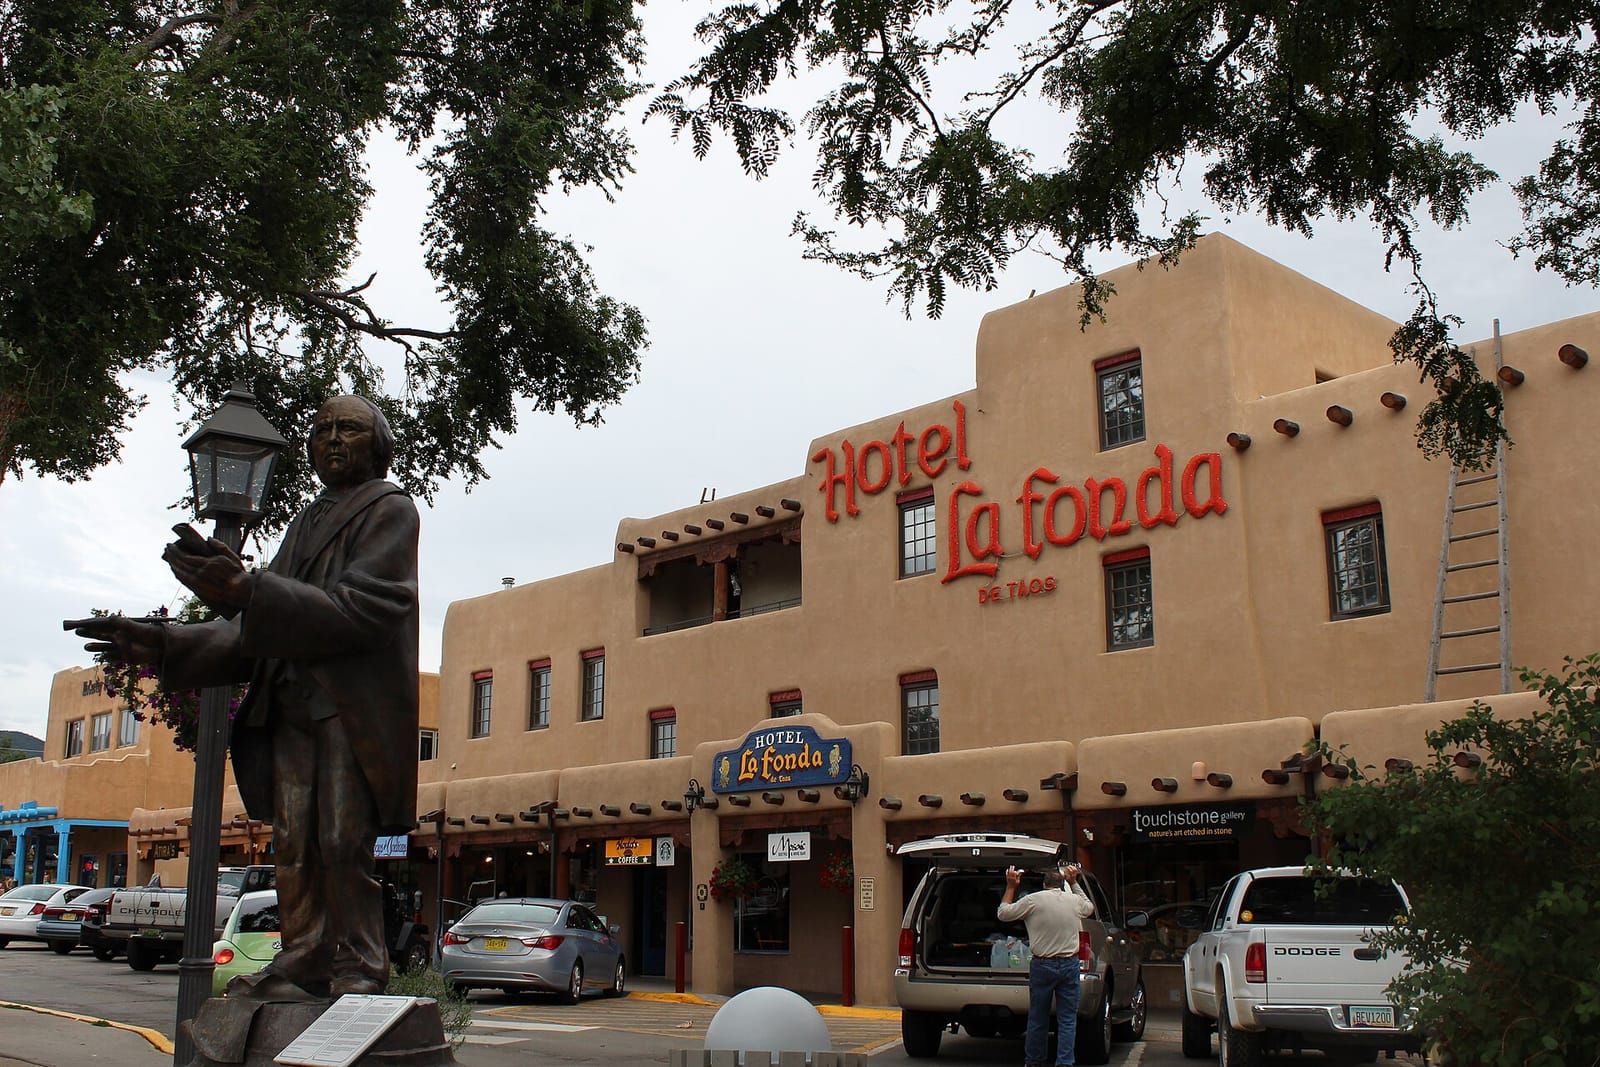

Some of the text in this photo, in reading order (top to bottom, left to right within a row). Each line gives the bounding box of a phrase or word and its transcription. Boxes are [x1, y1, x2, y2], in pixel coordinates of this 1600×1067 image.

[812, 399, 972, 523] Hotel
[941, 480, 1005, 584] La
[978, 576, 1057, 605] DE TAOS
[755, 731, 804, 750] HOTEL
[738, 748, 759, 781] La
[1133, 810, 1246, 832] touchstone gallery
[1148, 827, 1233, 838] nature's art etched in stone
[617, 856, 639, 864] COFFEE
[1274, 947, 1342, 956] DODGE
